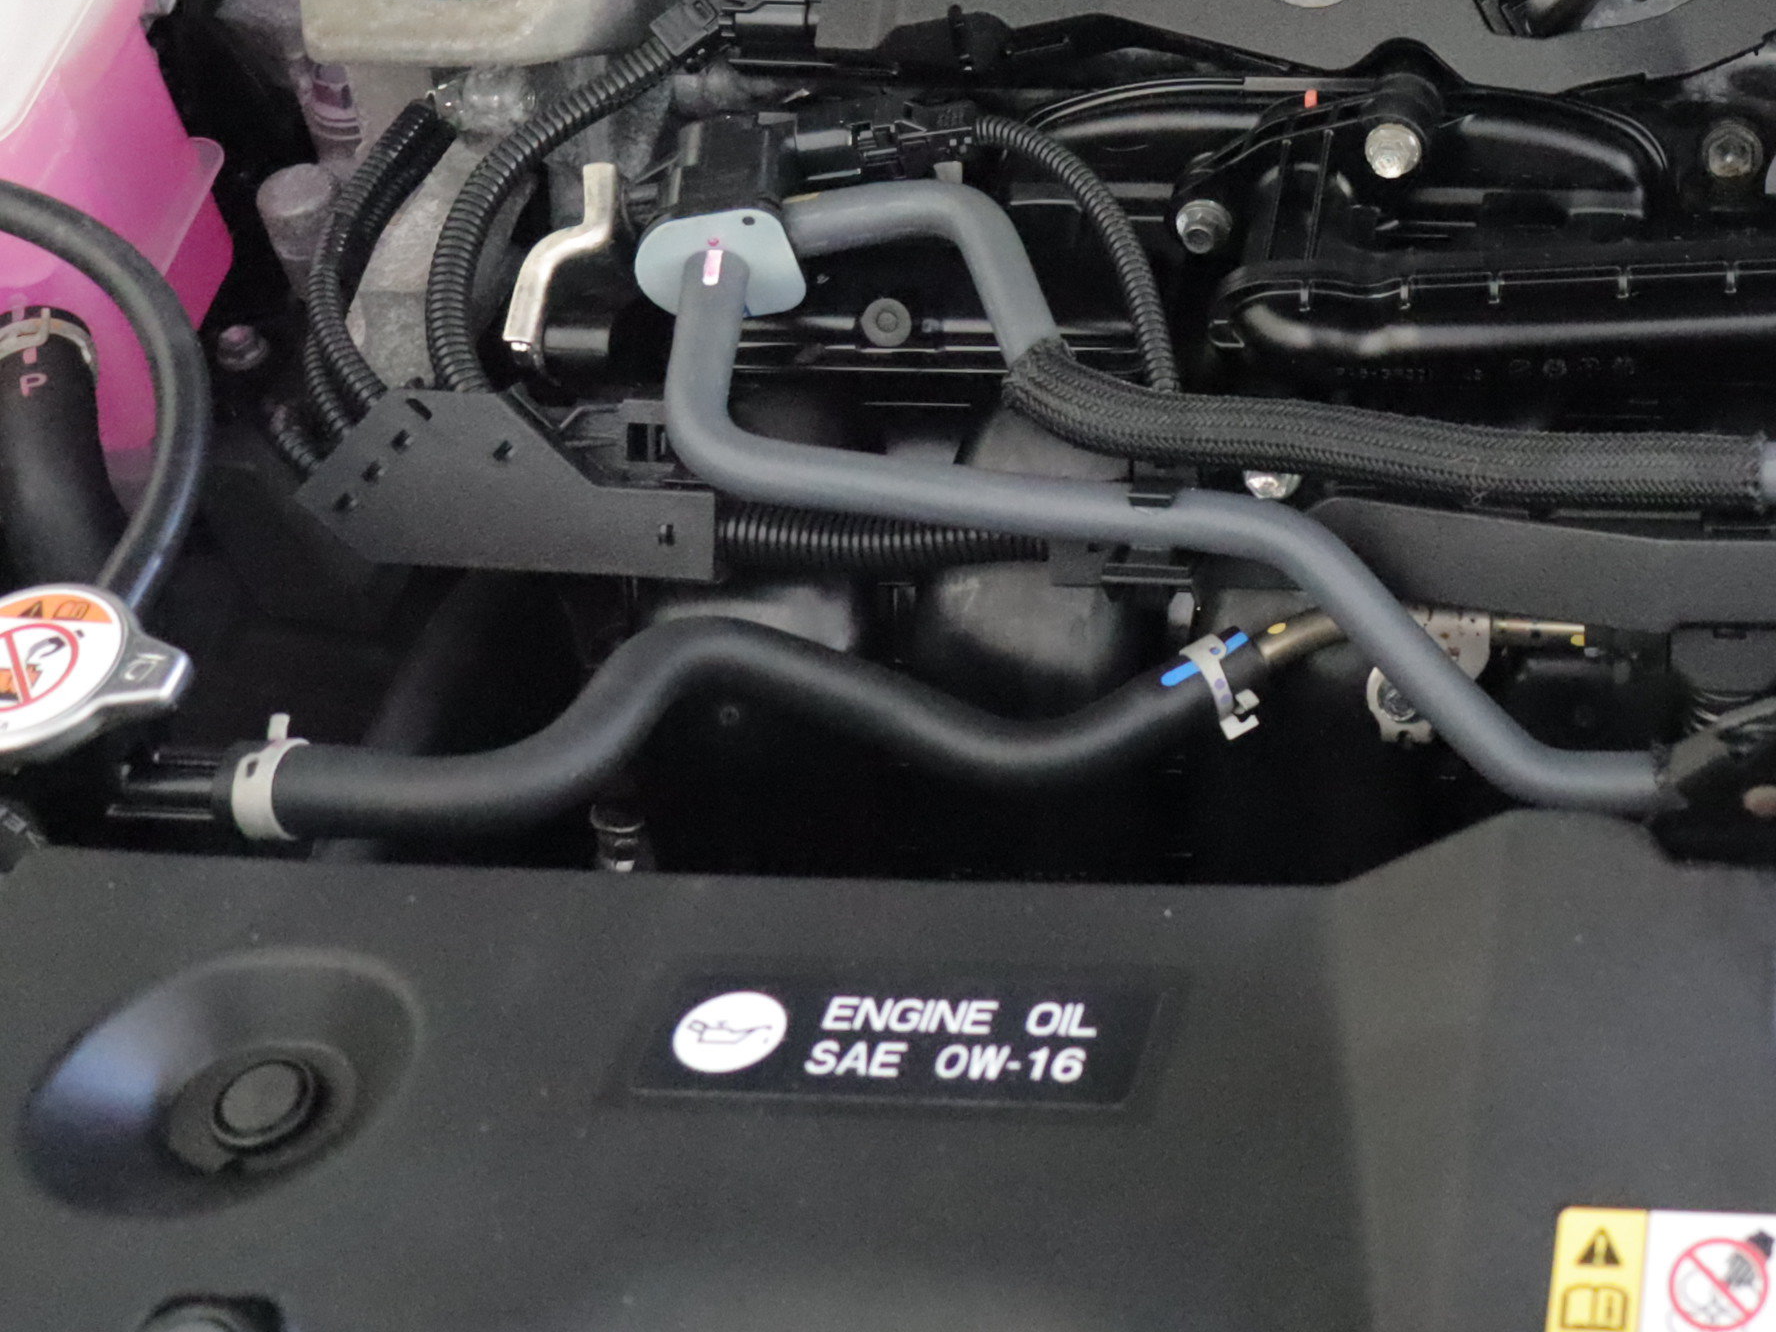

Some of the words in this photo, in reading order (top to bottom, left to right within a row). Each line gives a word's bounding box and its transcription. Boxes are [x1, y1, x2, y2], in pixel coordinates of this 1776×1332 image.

[822, 996, 999, 1035] ENGINE
[1026, 1001, 1098, 1038] OIL
[804, 1040, 909, 1078] SAE
